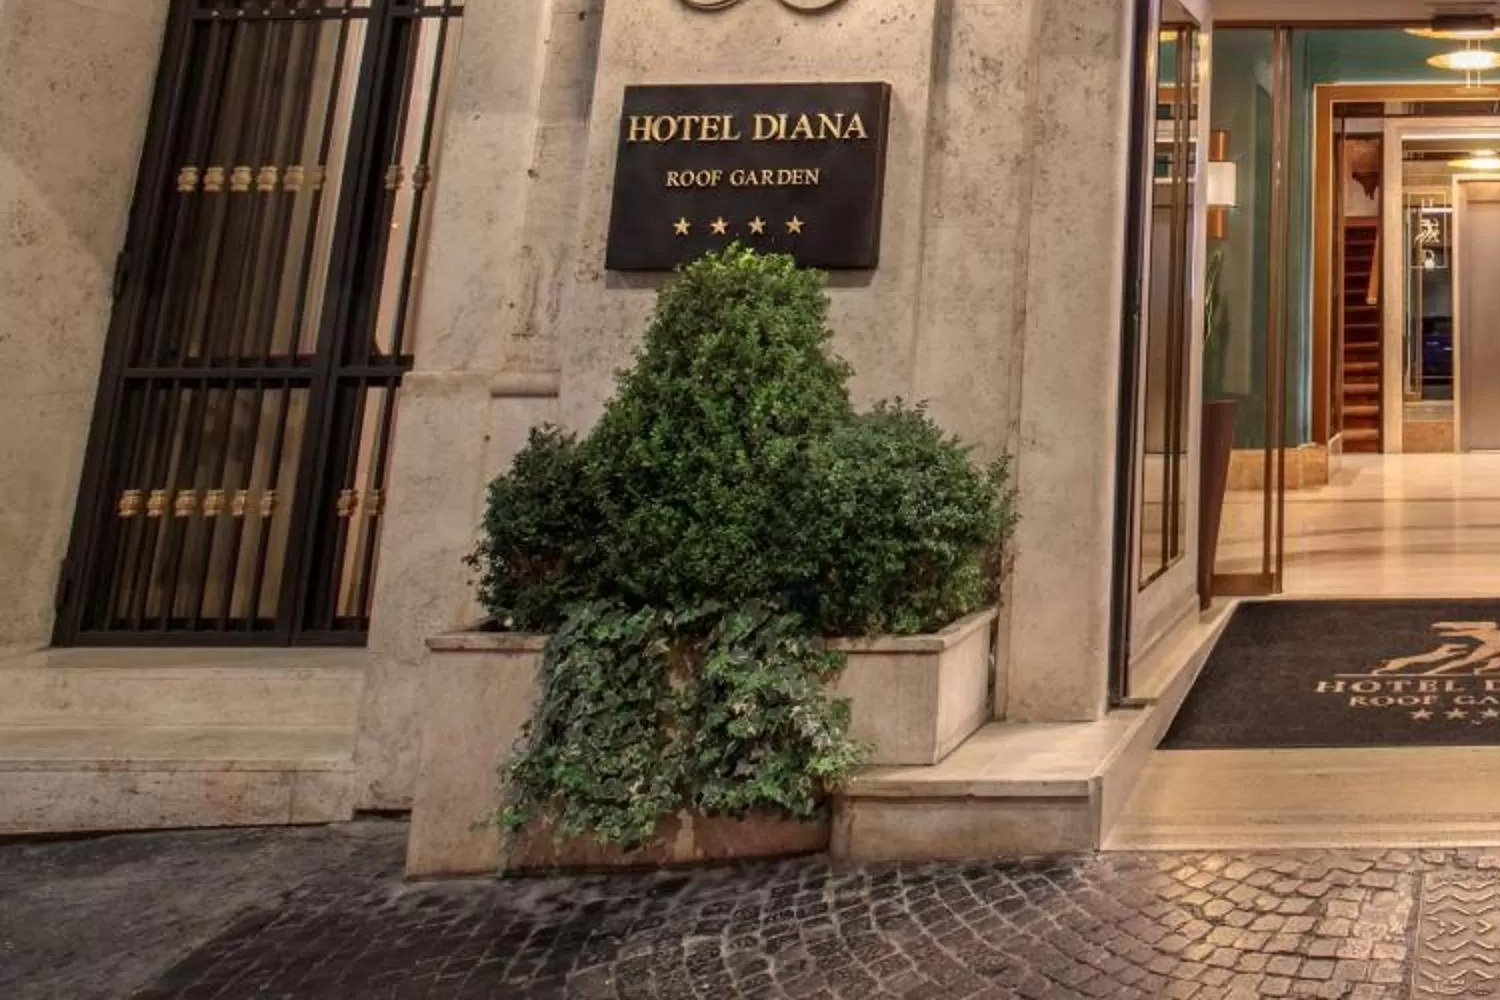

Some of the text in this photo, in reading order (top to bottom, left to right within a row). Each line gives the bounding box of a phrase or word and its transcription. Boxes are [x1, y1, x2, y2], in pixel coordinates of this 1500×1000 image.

[626, 111, 869, 142] HOTEL DIANA
[665, 167, 821, 188] ROOF GARDEN
[1313, 679, 1469, 694] HOTEL
[1348, 694, 1440, 708] ROOF
